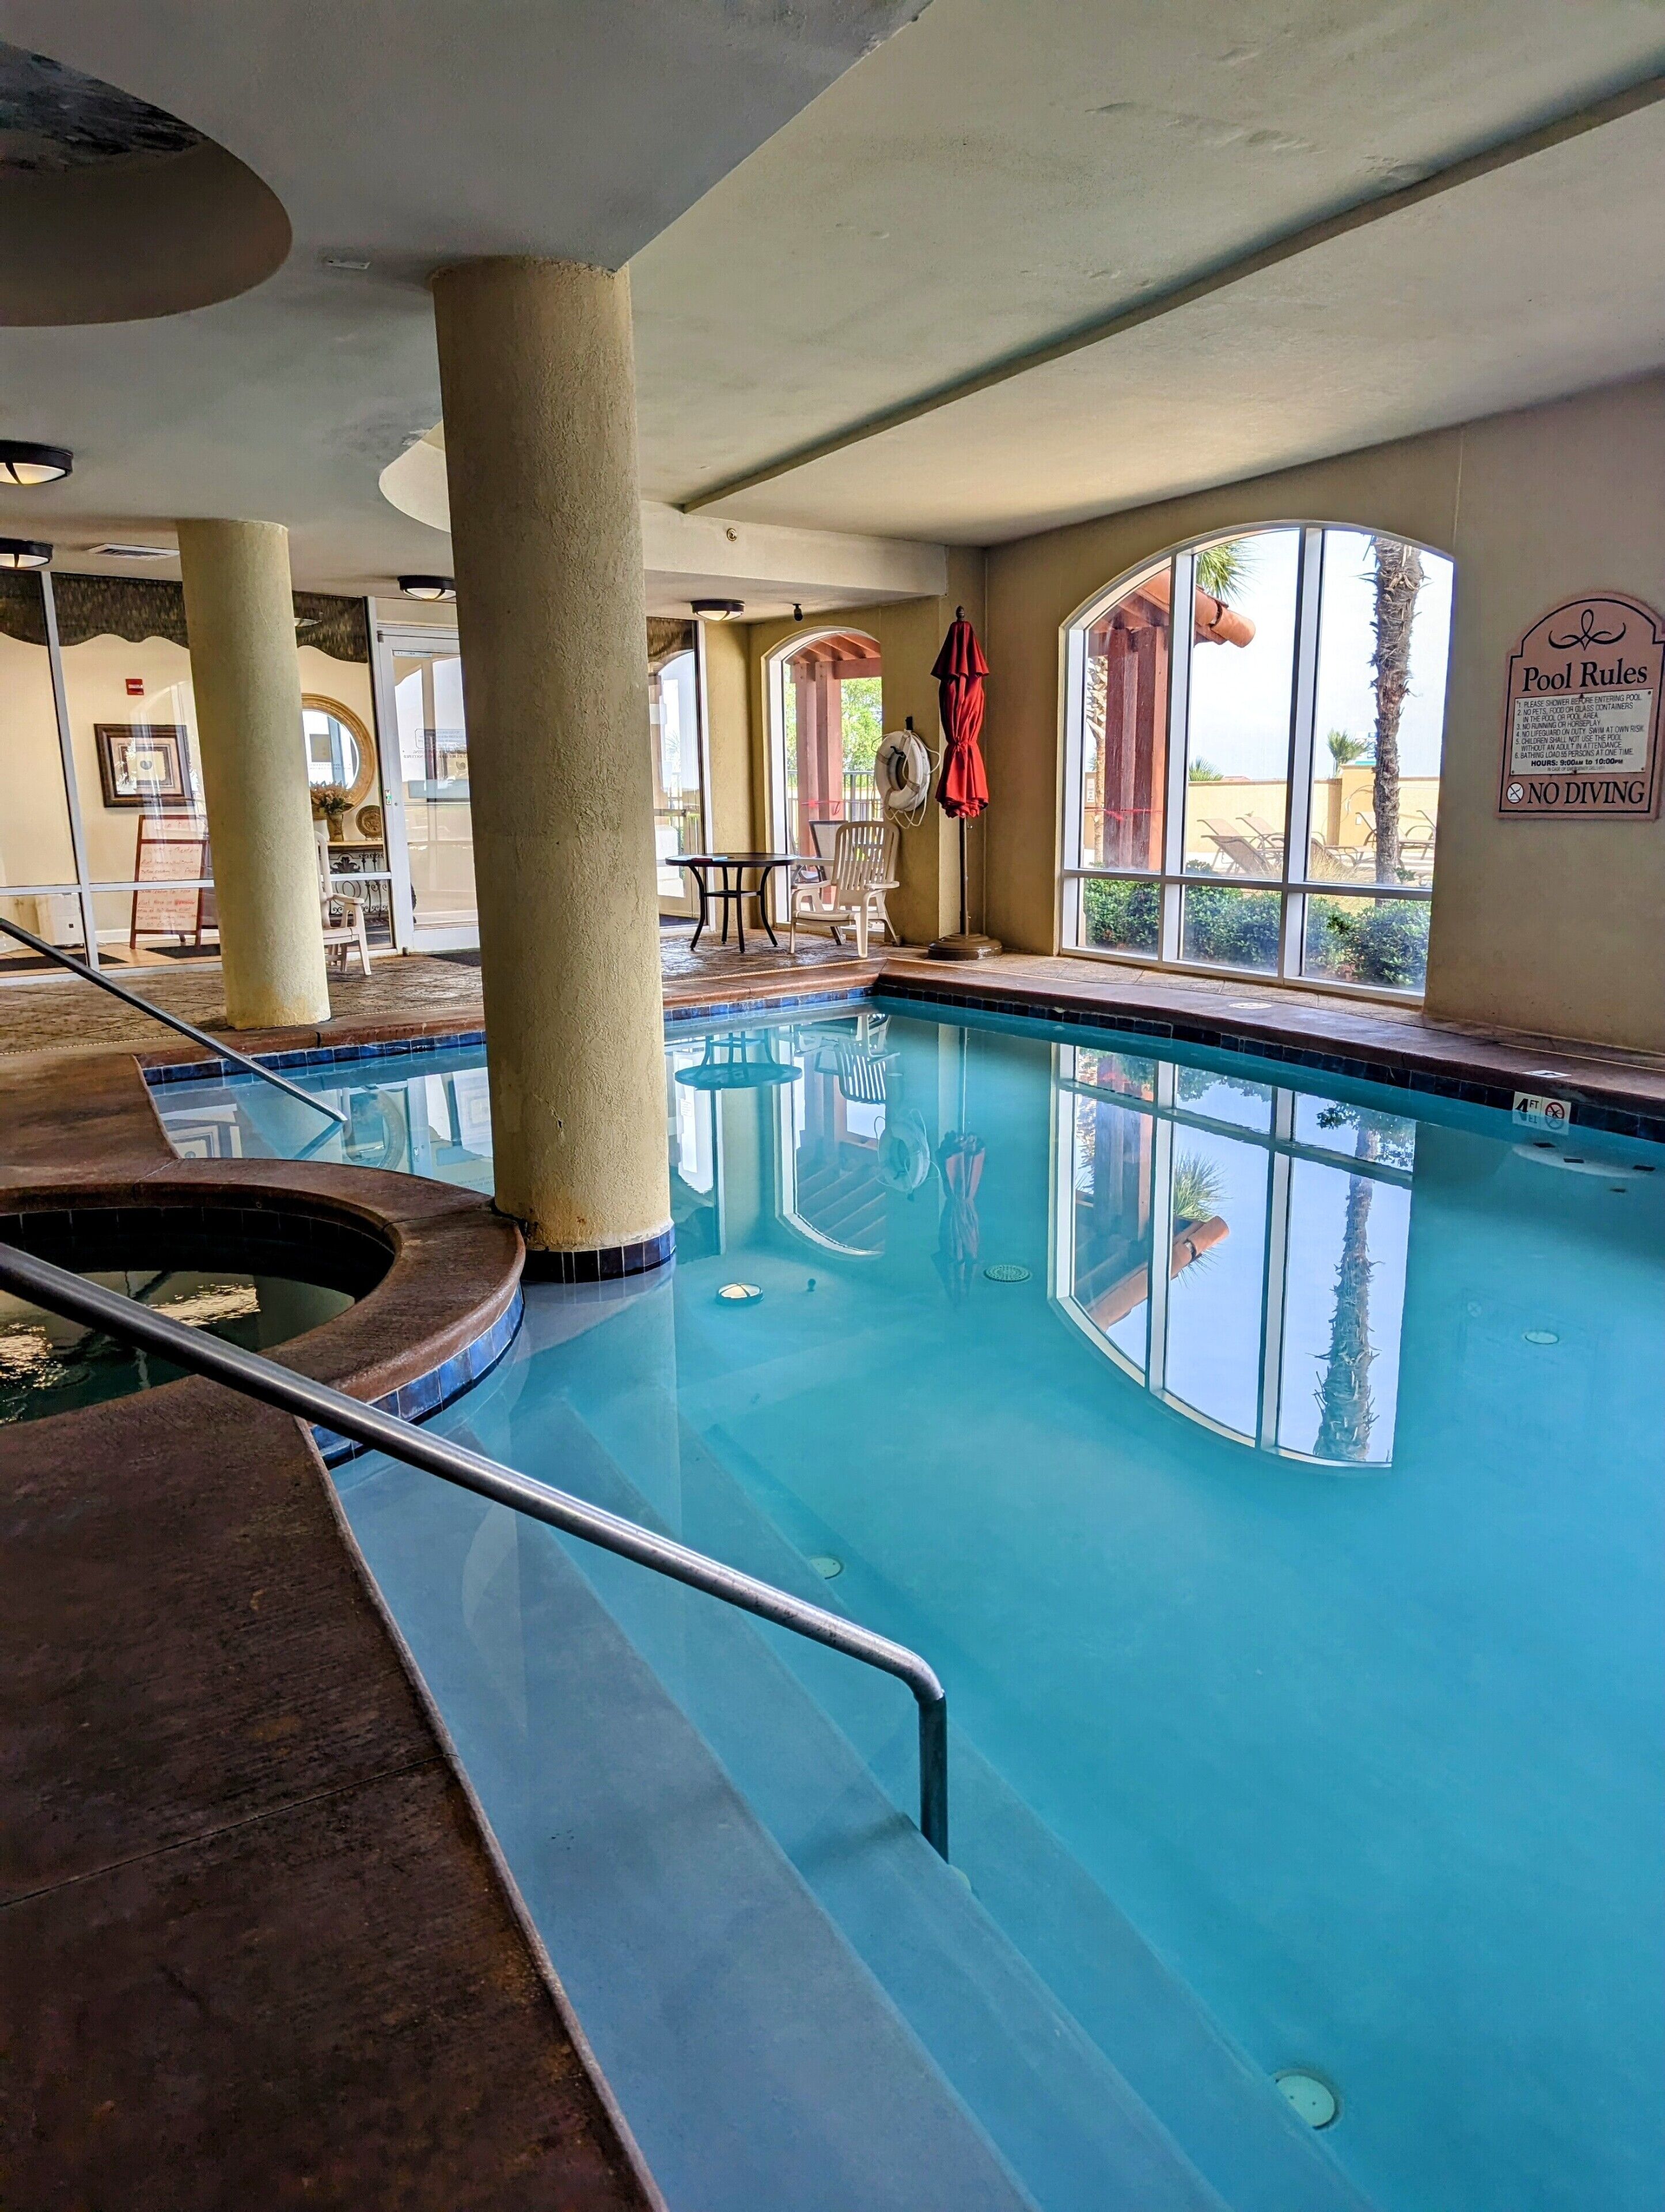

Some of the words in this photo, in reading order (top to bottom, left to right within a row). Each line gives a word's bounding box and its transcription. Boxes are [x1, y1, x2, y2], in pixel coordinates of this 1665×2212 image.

[1522, 662, 1572, 692] Pool
[1579, 658, 1648, 687] Rules
[1571, 696, 1593, 704] BEFORE
[1594, 695, 1624, 703] ENTERING
[1575, 704, 1594, 713] GLASS
[1595, 703, 1633, 711] CONTAINERS
[1531, 729, 1561, 737] LIFEGUARD
[1520, 751, 1543, 759] BATHING
[1568, 749, 1594, 757] PERSONS
[1527, 782, 1560, 804] NO
[1564, 781, 1645, 804] DIVING
[1515, 1098, 1529, 1113] 4
[1530, 1100, 1539, 1109] FT
